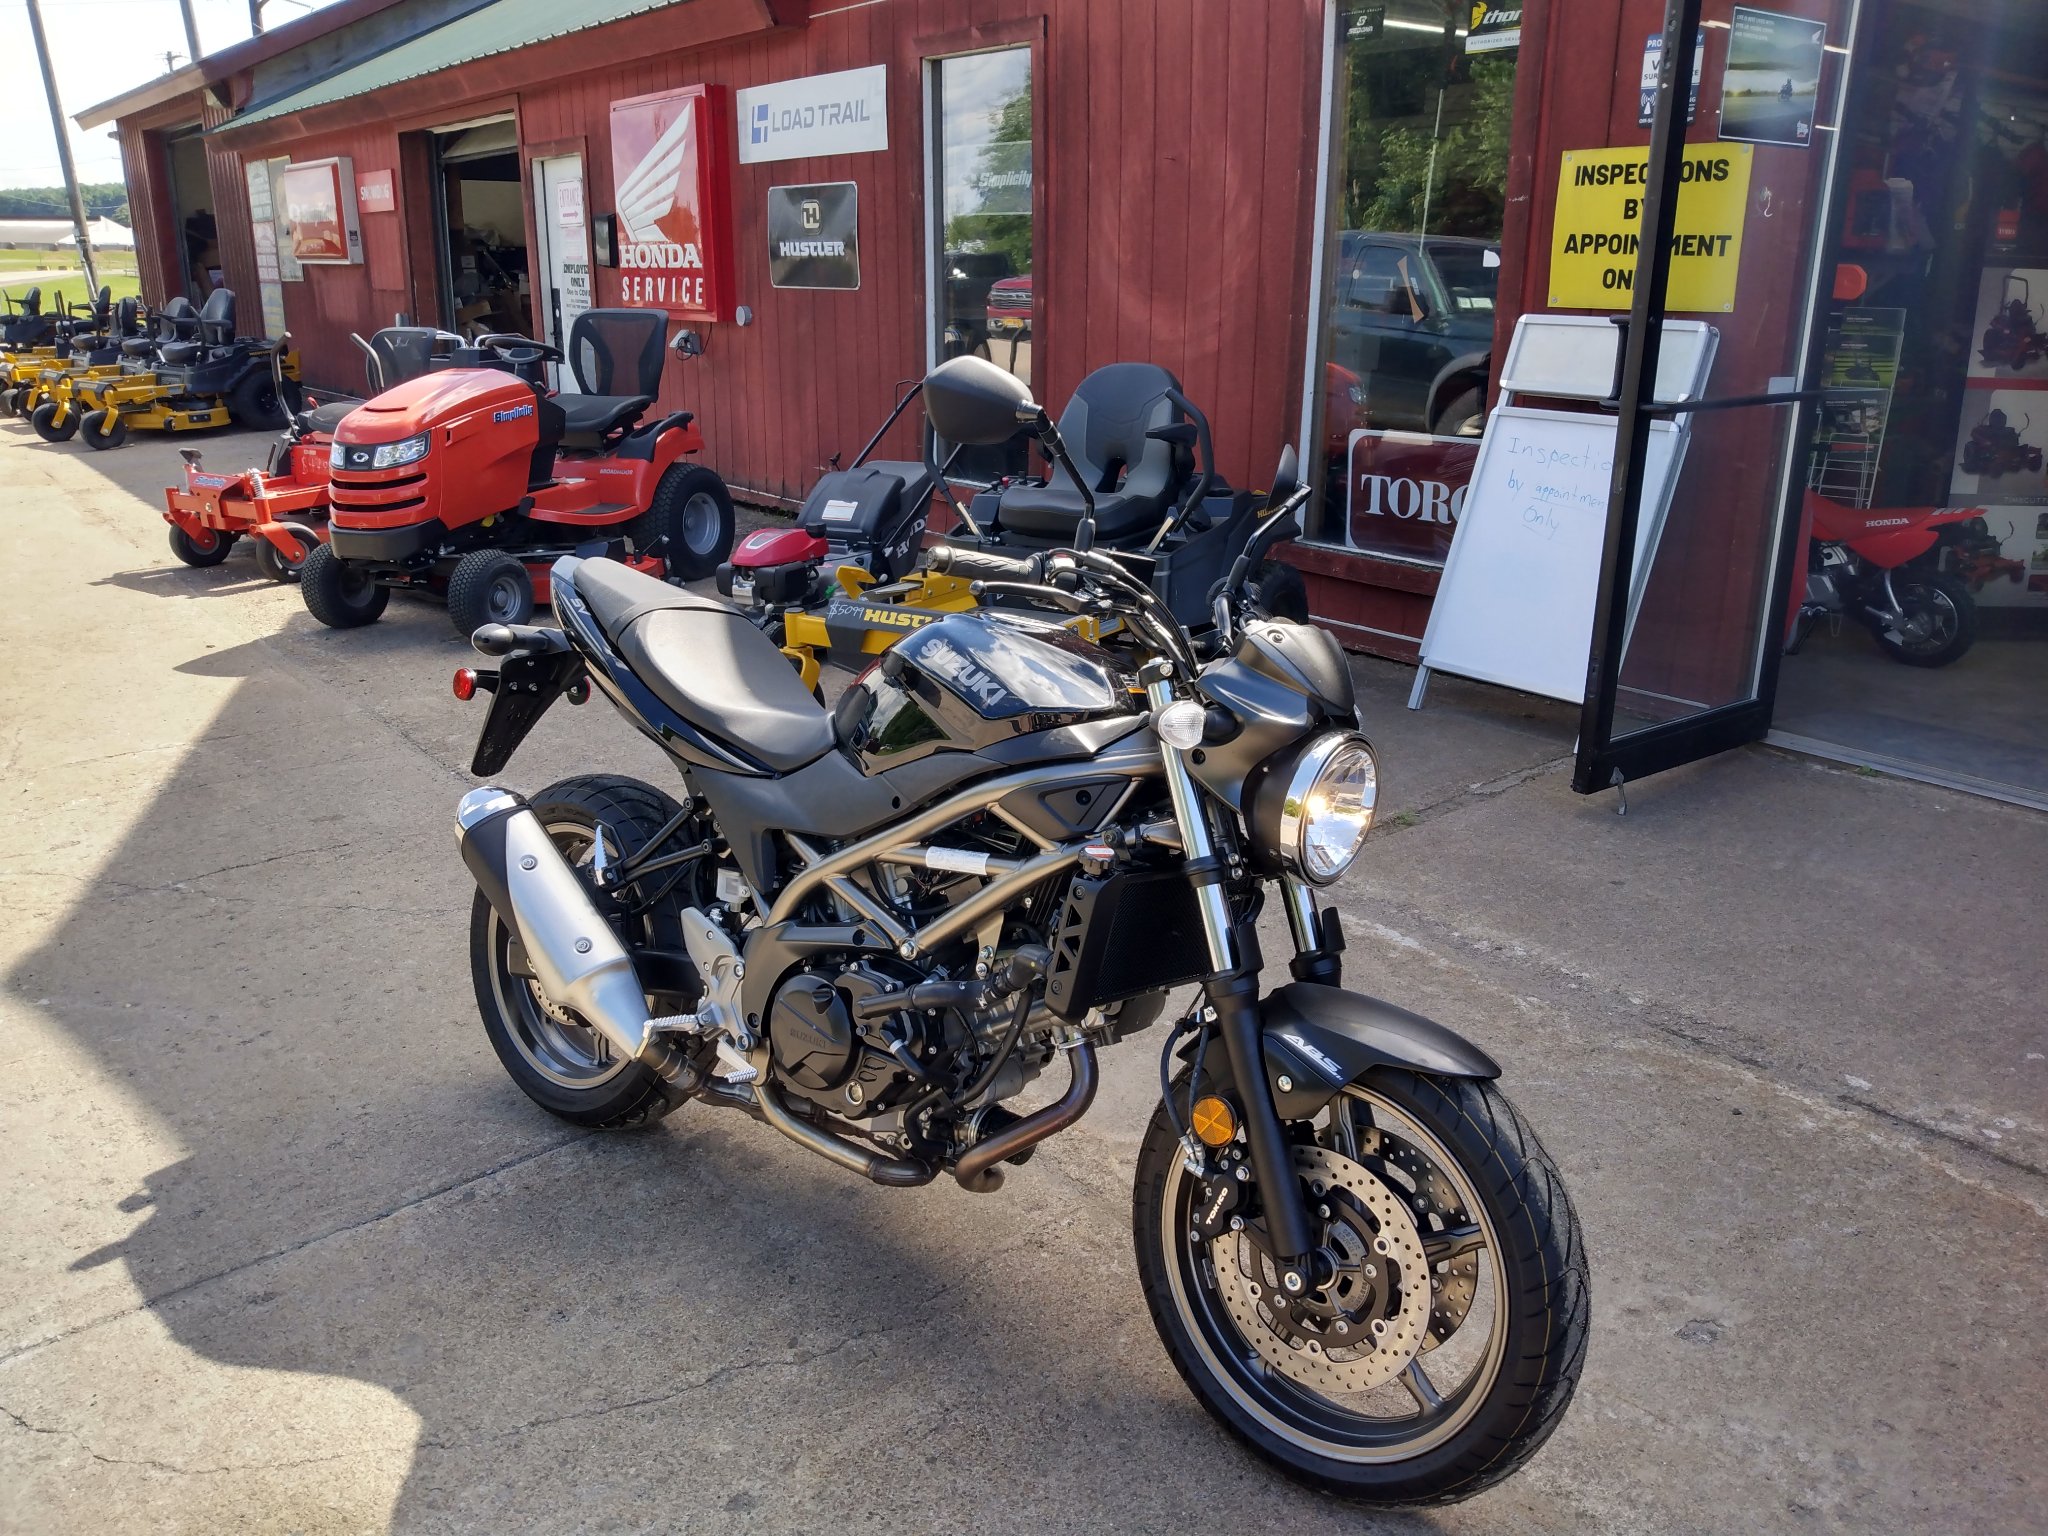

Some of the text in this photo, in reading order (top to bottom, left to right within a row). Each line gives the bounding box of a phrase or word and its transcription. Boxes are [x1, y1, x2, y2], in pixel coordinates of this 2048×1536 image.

[1483, 9, 1523, 24] thor
[771, 99, 870, 133] LOAD TRAIL
[978, 169, 1032, 190] Simplicity
[1574, 158, 1730, 187] INSPECONS
[1623, 198, 1645, 220] B
[618, 243, 703, 269] HONDA
[779, 241, 845, 257] HUSTLER
[1563, 233, 1732, 257] APPOINMENT
[622, 276, 704, 305] SERVICE
[1602, 268, 1635, 290] ON
[493, 404, 534, 423] Simplicity
[1507, 437, 1612, 472] Inspectio
[1507, 469, 1607, 508] by appointmen
[1522, 505, 1560, 532] Only
[1865, 517, 1910, 527] HONDA
[826, 600, 865, 619] $5099
[864, 608, 933, 628] HUST
[921, 638, 1008, 707] SUZUKI
[1281, 1033, 1344, 1080] ABS
[1205, 1187, 1229, 1225] TOKICO
